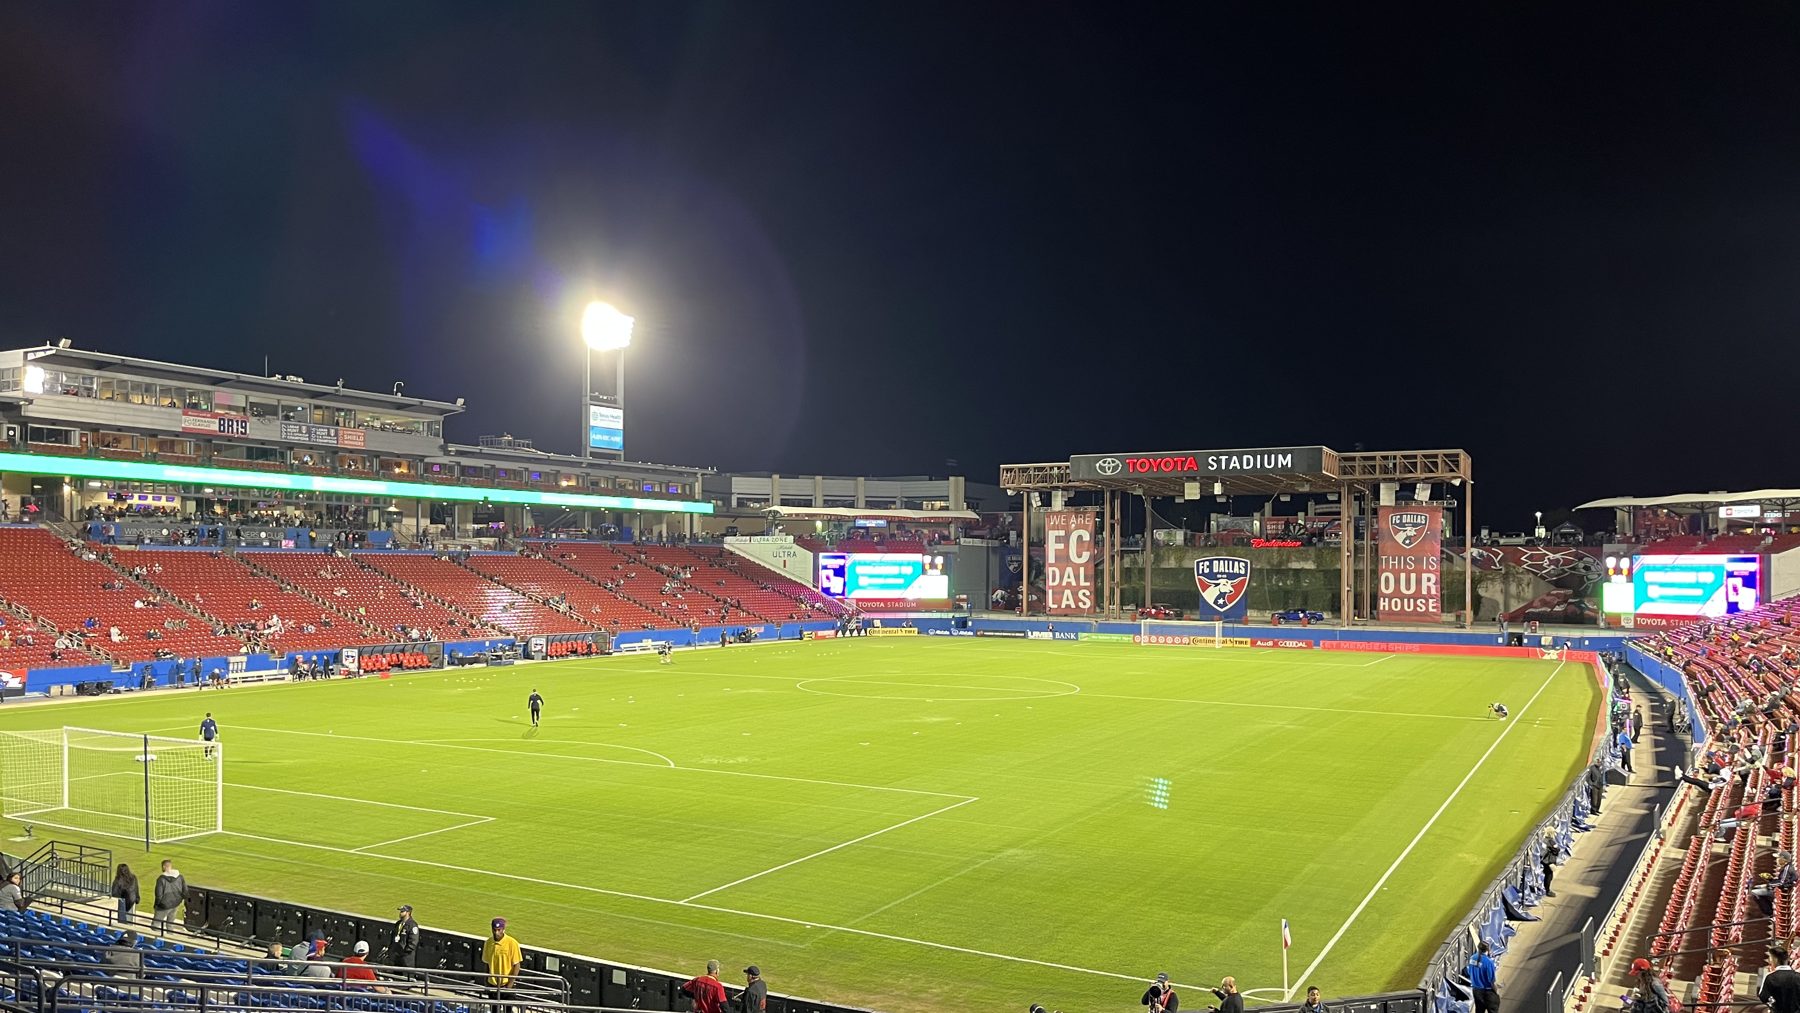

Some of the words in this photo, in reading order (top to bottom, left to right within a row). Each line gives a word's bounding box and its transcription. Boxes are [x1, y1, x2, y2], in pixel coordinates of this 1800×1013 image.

[218, 417, 247, 435] BR19
[1126, 456, 1199, 474] TOYOTA
[1208, 454, 1292, 471] STADIUM
[1050, 514, 1066, 525] WE
[1070, 514, 1090, 524] ARE
[1392, 515, 1400, 524] FC
[1402, 514, 1426, 524] DALLAS
[1048, 529, 1090, 564] FC
[1251, 539, 1302, 548] Budweiser
[1198, 561, 1210, 574] FC
[1212, 560, 1246, 574] DALLAS
[1381, 556, 1414, 570] THIS
[1423, 556, 1436, 570] IS
[1048, 567, 1090, 587] DAL
[1380, 572, 1436, 594] OUR
[1048, 589, 1091, 609] LAS
[1380, 598, 1436, 612] HOUSE
[1340, 642, 1420, 651] MEMBERSHIPS
